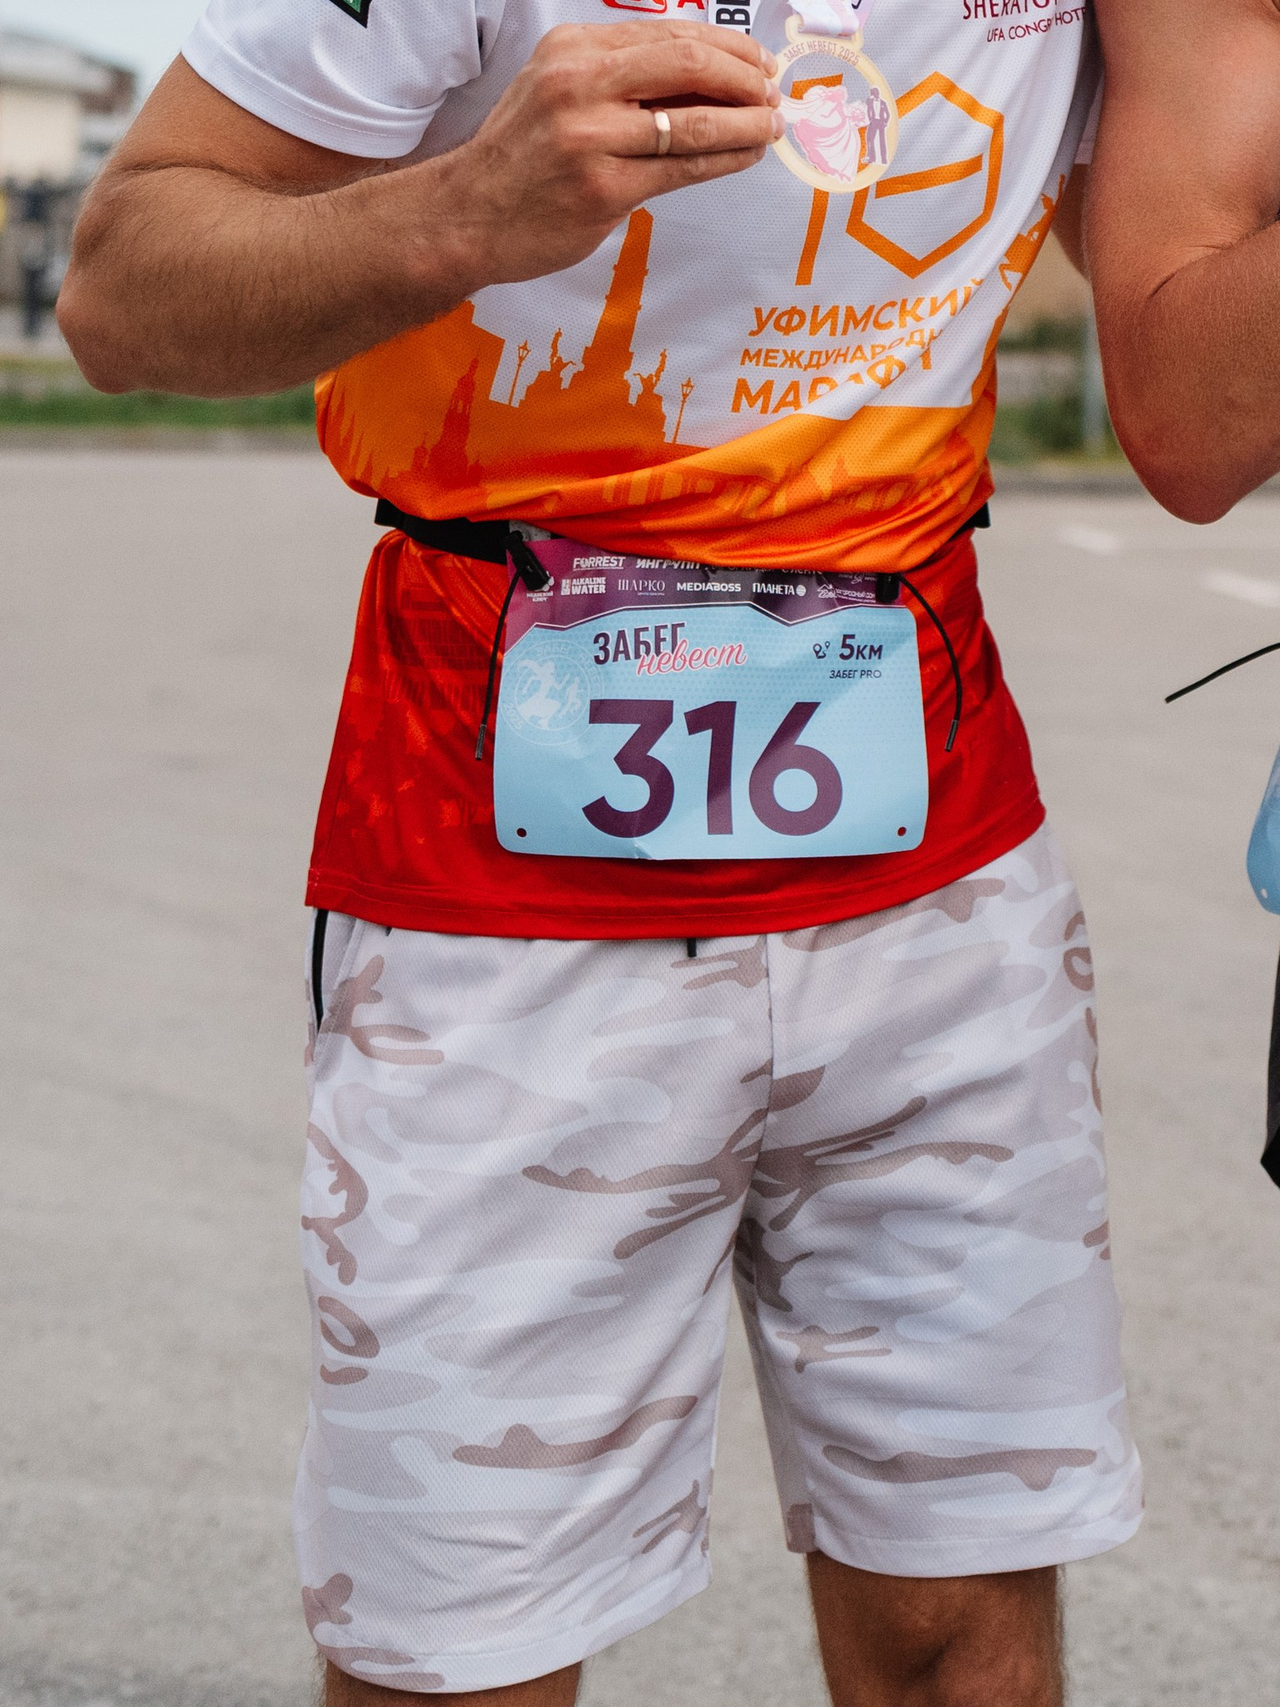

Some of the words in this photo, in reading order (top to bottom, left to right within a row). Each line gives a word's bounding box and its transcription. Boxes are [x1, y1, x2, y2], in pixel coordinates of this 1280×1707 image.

[987, 27, 1005, 42] UFA
[784, 45, 807, 63] ЗАБЕГ
[808, 40, 837, 55] НЕВЕСТ
[839, 46, 860, 66] 2025
[572, 584, 606, 595] WATER
[618, 579, 665, 591] ШАРКО
[677, 582, 741, 591] MEDIABOSS
[752, 582, 795, 595] ПЛАНЕТА
[593, 622, 685, 665] ЗАБЕГ
[636, 639, 747, 676] невест
[829, 669, 858, 679] ЗАБЕГ
[860, 669, 882, 679] PRO
[582, 699, 843, 839] 316
